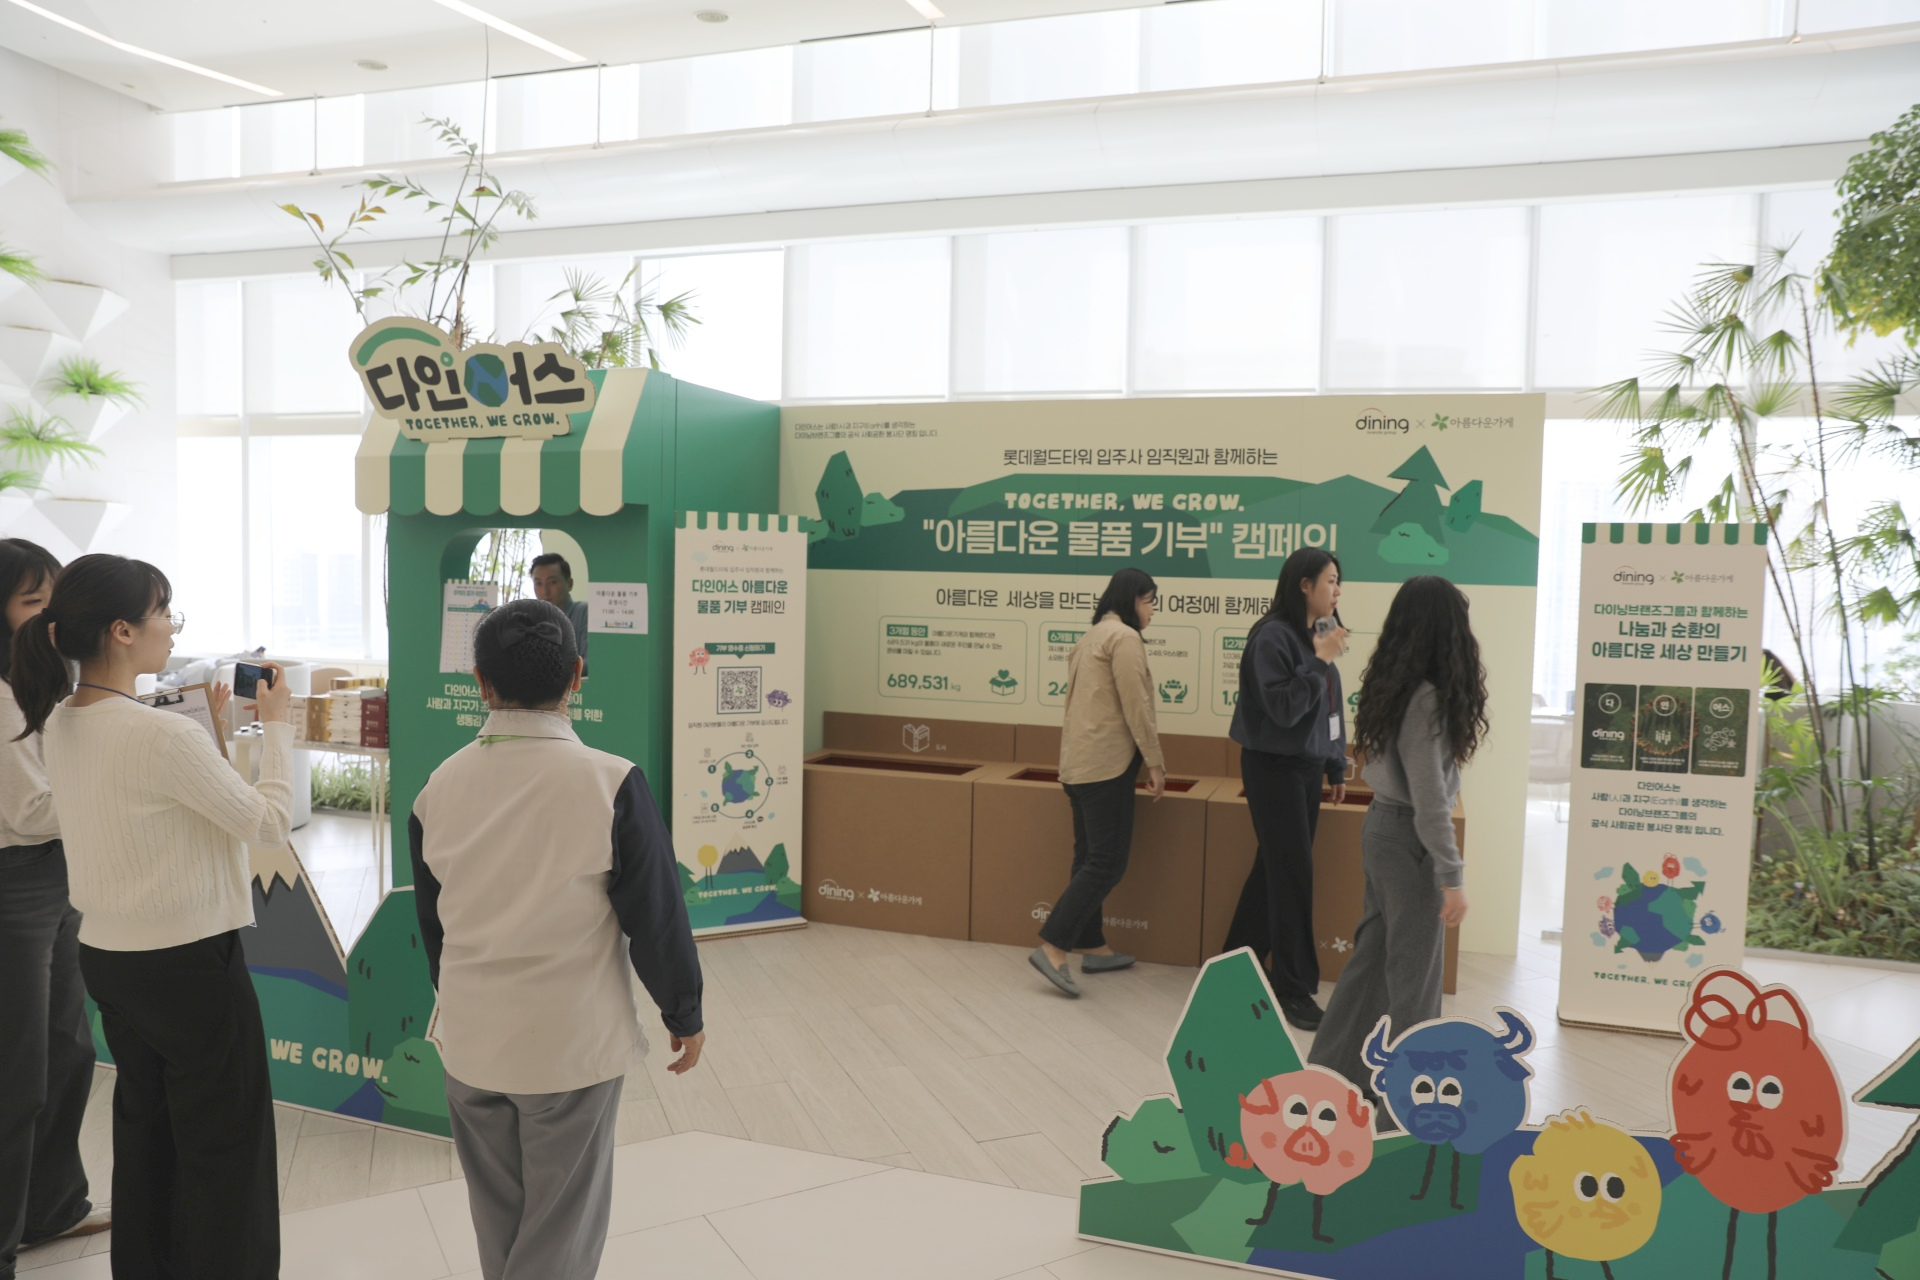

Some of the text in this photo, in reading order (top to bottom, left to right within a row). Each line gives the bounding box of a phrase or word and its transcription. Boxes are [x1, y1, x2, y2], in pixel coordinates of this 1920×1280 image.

[365, 351, 585, 412] 다인어스
[405, 412, 560, 431] TOGETHER, WE GROW.
[1355, 415, 1410, 434] dining
[1449, 416, 1514, 429] 아름다운가게
[1003, 448, 1278, 466] 롯데월드타워 입주사 임직원과 함께하는
[1004, 492, 1245, 512] TOGETHER, WE GROW.
[923, 519, 1059, 556] "아름다운
[1068, 521, 1132, 558] 물품
[1140, 521, 1222, 558] 기부"
[712, 544, 734, 552] dining
[1613, 571, 1655, 585] dining
[692, 580, 788, 594] 다인어스 아름다운
[697, 600, 785, 614] 물품 기부 캠페인
[936, 588, 998, 608] 아름다운
[1006, 590, 1054, 610] 세상을
[1168, 594, 1220, 614] 여정에
[1594, 603, 1748, 619] 다이닝브랜즈그룹과 함께하는
[1619, 621, 1720, 639] 나눔과 순환의
[1592, 642, 1747, 662] 아름다운 세상 만들기
[886, 674, 961, 692] 689,531 kg
[426, 697, 451, 710] 사람과
[453, 699, 479, 712] 지구가
[584, 708, 603, 722] 위한
[1606, 699, 1615, 708] 다
[1660, 700, 1670, 710] 인
[1712, 703, 1731, 712] 어스
[456, 714, 482, 727] 생동감
[1592, 729, 1625, 741] dining
[1637, 781, 1681, 792] 다인어스는
[1692, 798, 1727, 809] 생각하는
[1618, 807, 1697, 820] 다이닝브랜즈그룹의
[1591, 819, 1608, 828] 공식
[1610, 820, 1644, 831] 사회공헌
[1675, 824, 1692, 834] 명칭
[818, 884, 854, 901] dining
[270, 1038, 388, 1083] WE GROW.
